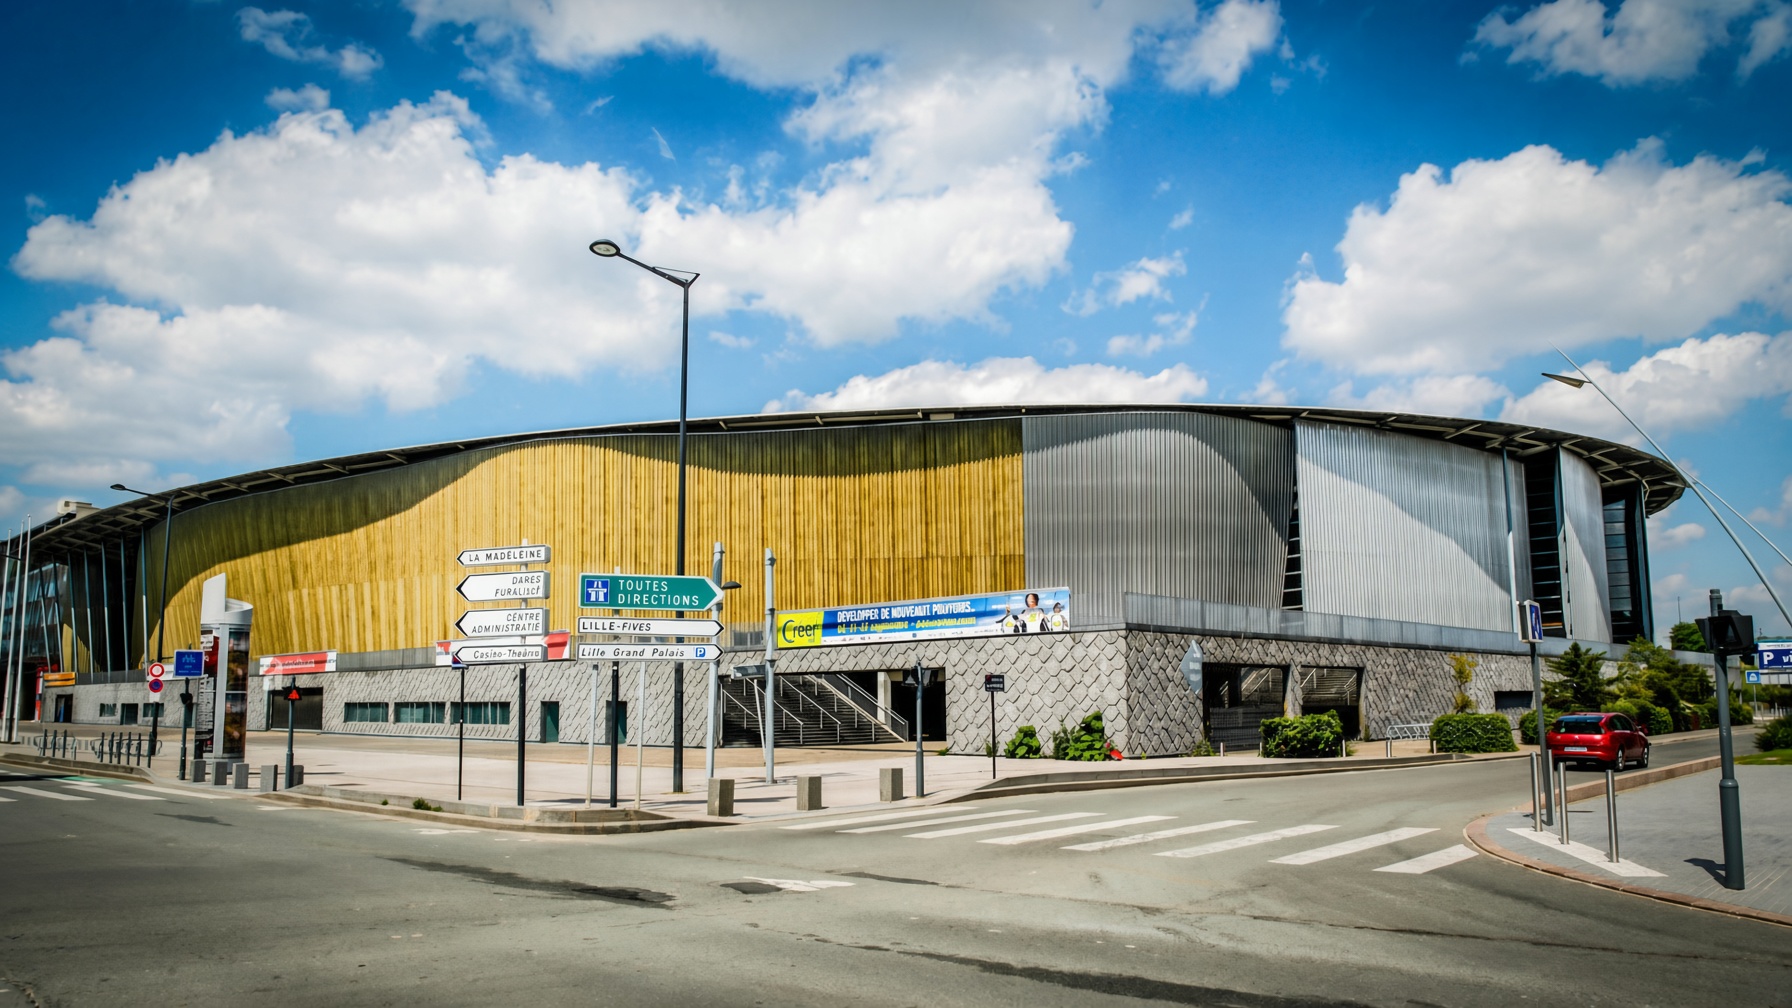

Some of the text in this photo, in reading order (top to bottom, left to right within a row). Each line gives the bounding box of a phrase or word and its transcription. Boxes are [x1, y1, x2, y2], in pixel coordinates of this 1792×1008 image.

[468, 553, 480, 562] LA
[618, 579, 668, 592] TOUTES
[617, 594, 699, 606] DIRECTIONS
[582, 621, 651, 632] LILLE-FIVES
[581, 647, 705, 657] Lille Grand Palais P
[1762, 651, 1775, 665] P
